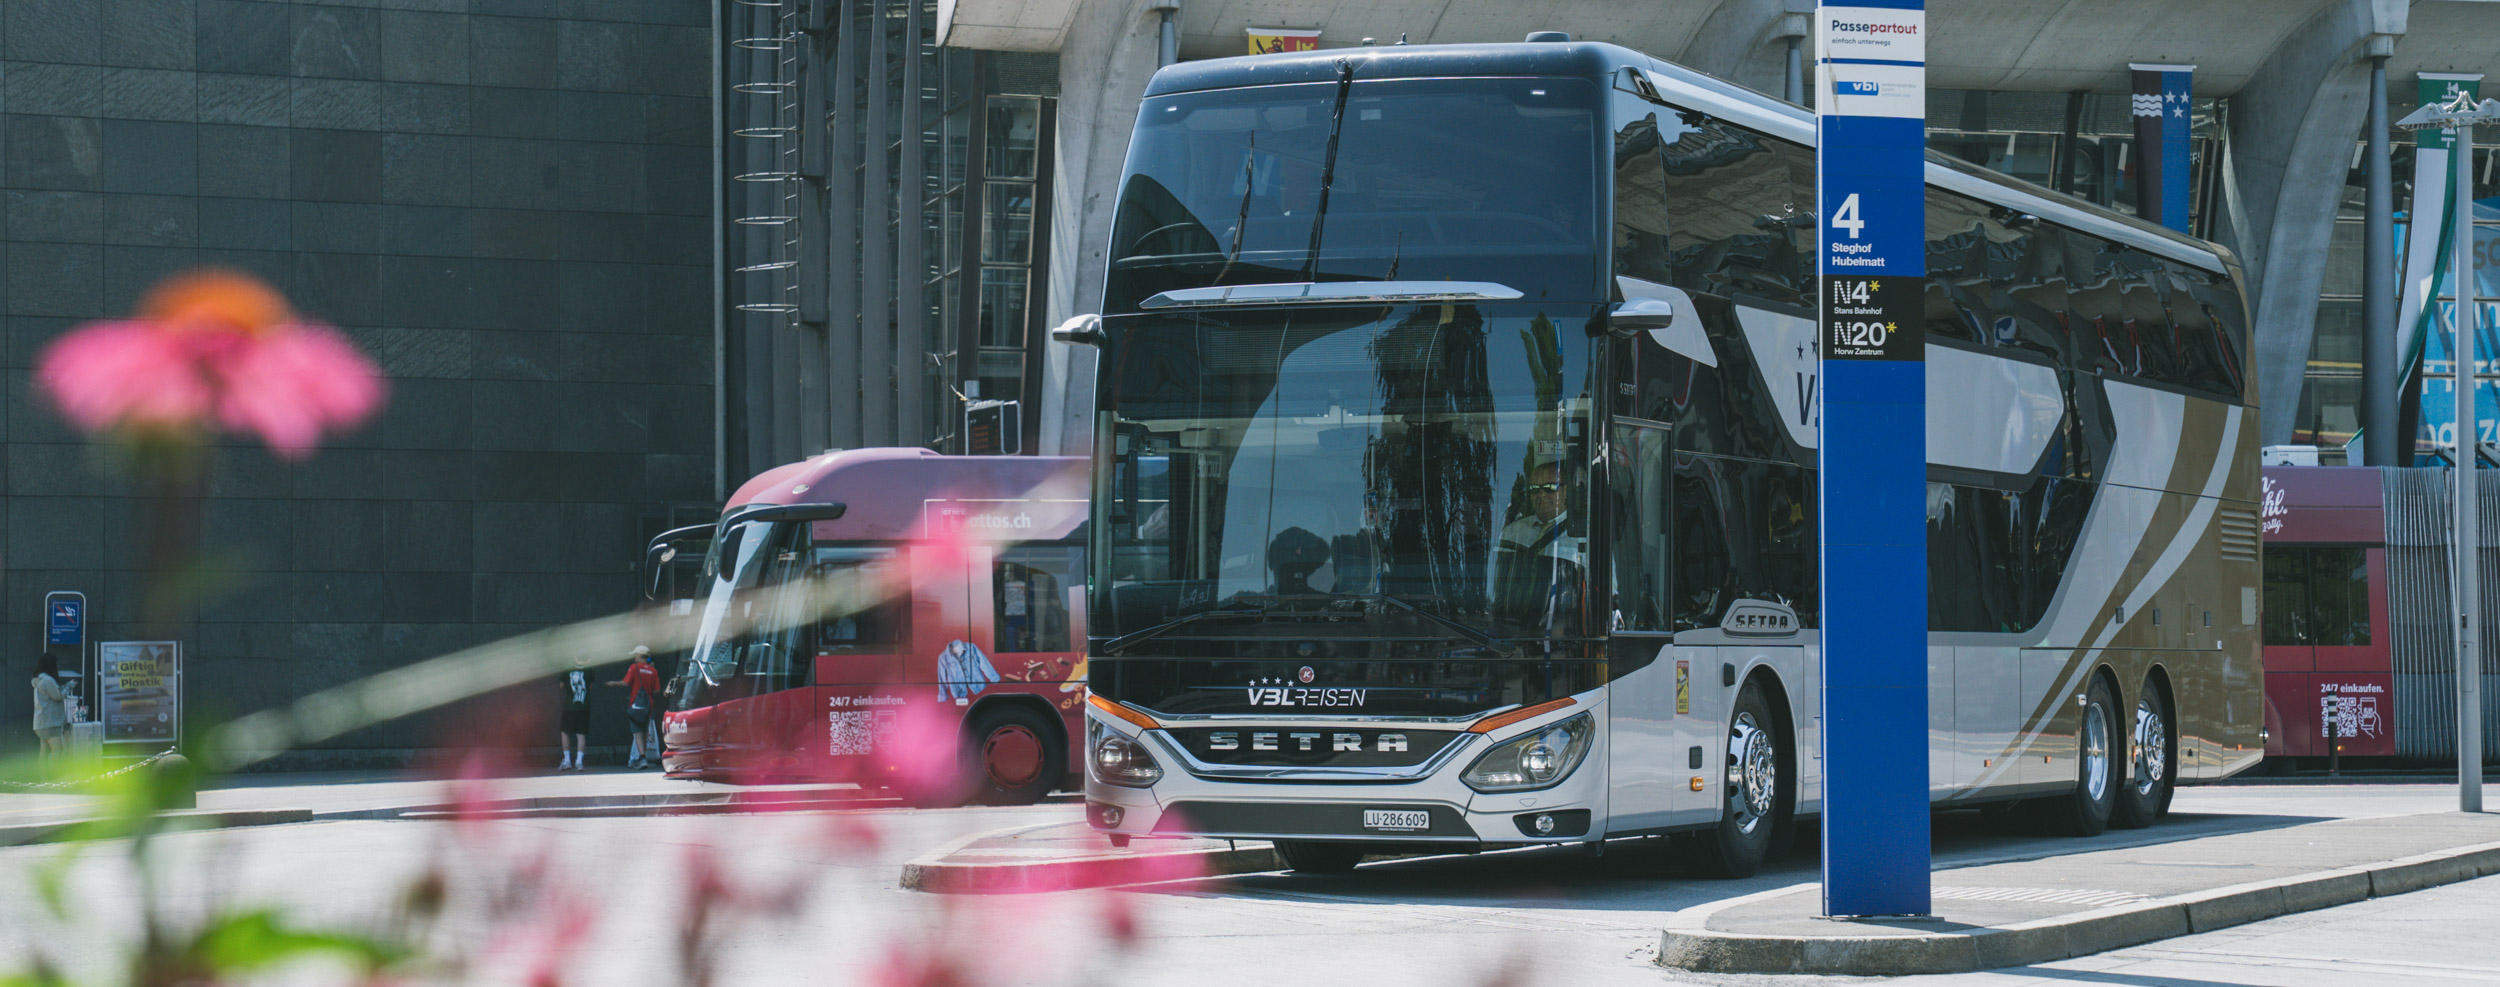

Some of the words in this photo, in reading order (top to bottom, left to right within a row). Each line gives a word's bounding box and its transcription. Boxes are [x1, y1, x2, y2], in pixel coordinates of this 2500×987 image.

[1832, 20, 1917, 35] Passepartout
[1852, 82, 1878, 91] vbl
[1832, 193, 1864, 239] 4
[1832, 242, 1872, 255] Steghof
[1832, 256, 1885, 267] Hubelmatt
[1854, 307, 1882, 315] Bahnhof
[1797, 372, 1818, 427] V
[970, 512, 1031, 528] ottos.ch
[1736, 615, 1788, 628] SETRA
[120, 662, 154, 673] Giftig
[121, 677, 161, 687] Plastik
[2321, 684, 2338, 692] 24/7
[2340, 683, 2384, 693] einkaufen.
[829, 696, 850, 706] 24/7
[853, 695, 906, 706] einkaufen.
[1210, 732, 1408, 751] SETRA
